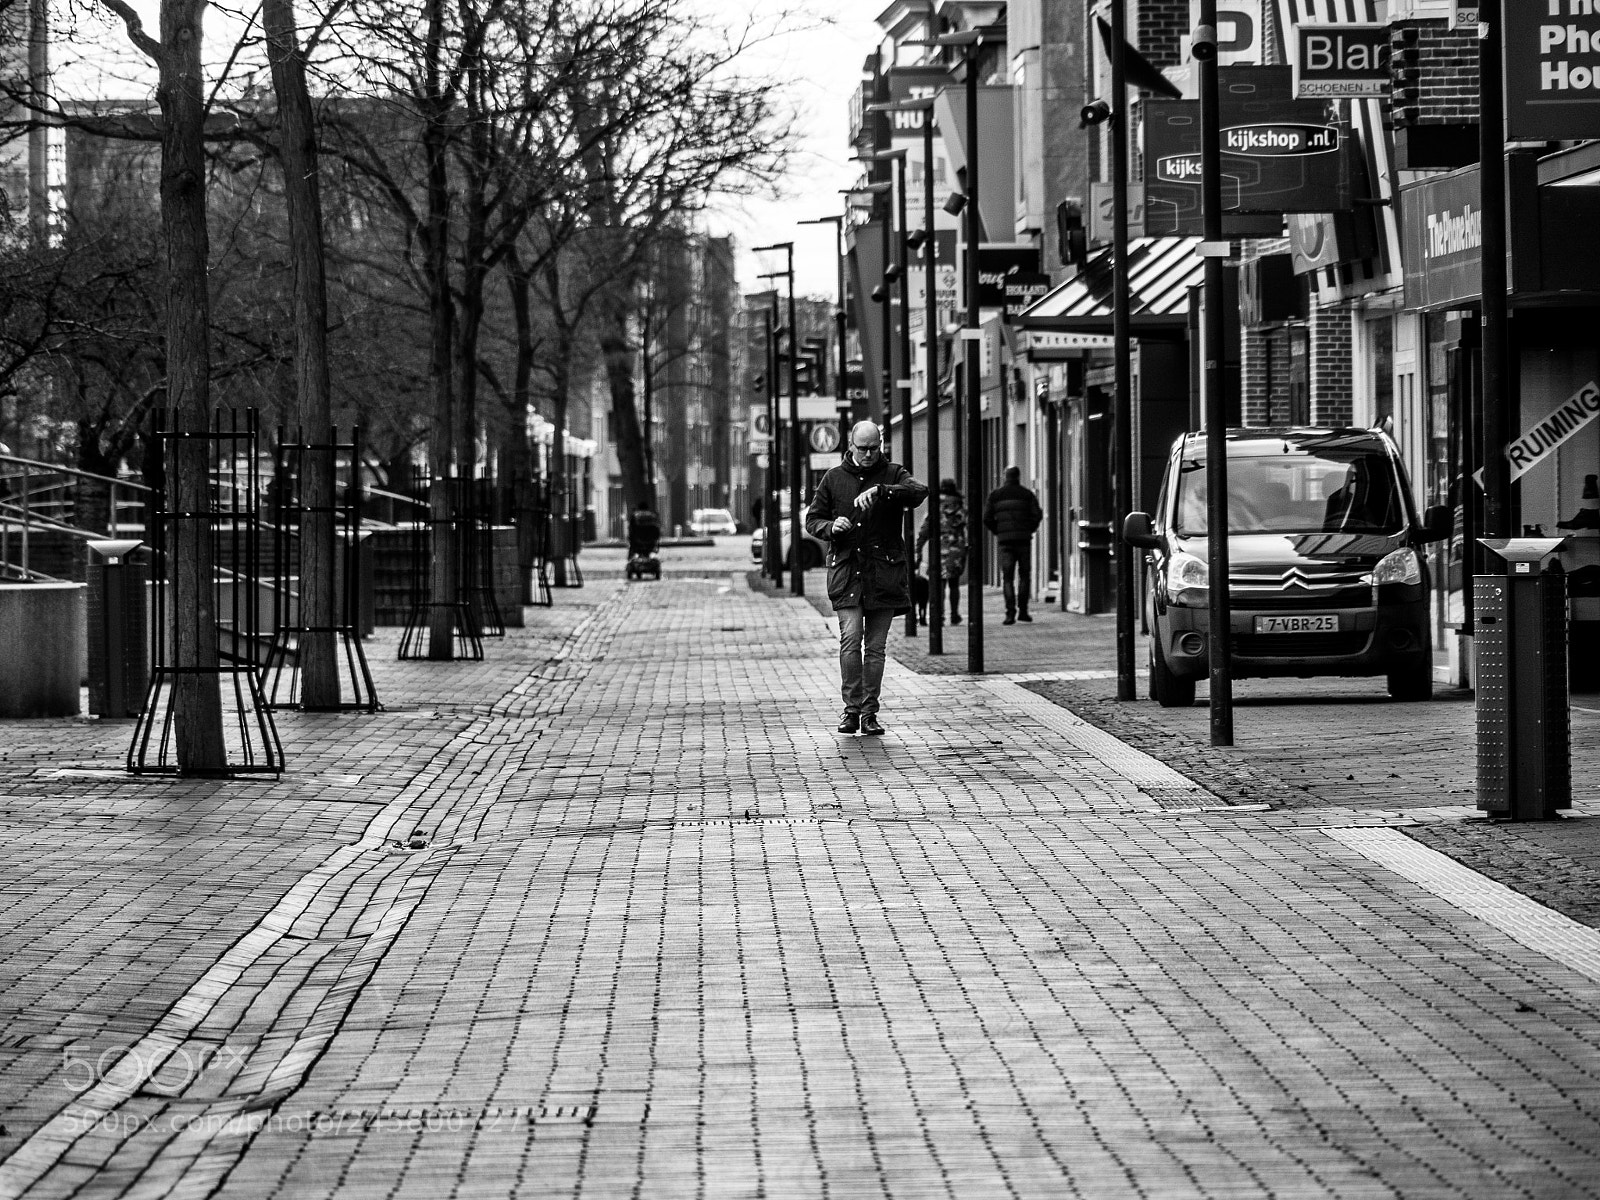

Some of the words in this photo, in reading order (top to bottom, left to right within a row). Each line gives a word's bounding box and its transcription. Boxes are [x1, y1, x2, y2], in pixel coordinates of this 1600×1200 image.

[1300, 83, 1362, 92] SCHOENEN
[1227, 130, 1299, 150] kijkshop
[1307, 130, 1329, 146] .nl
[1166, 160, 1202, 178] kijks
[1032, 336, 1108, 344] Wittevee
[1508, 389, 1600, 470] RUIMING
[1268, 617, 1334, 631] 7-VBR-25
